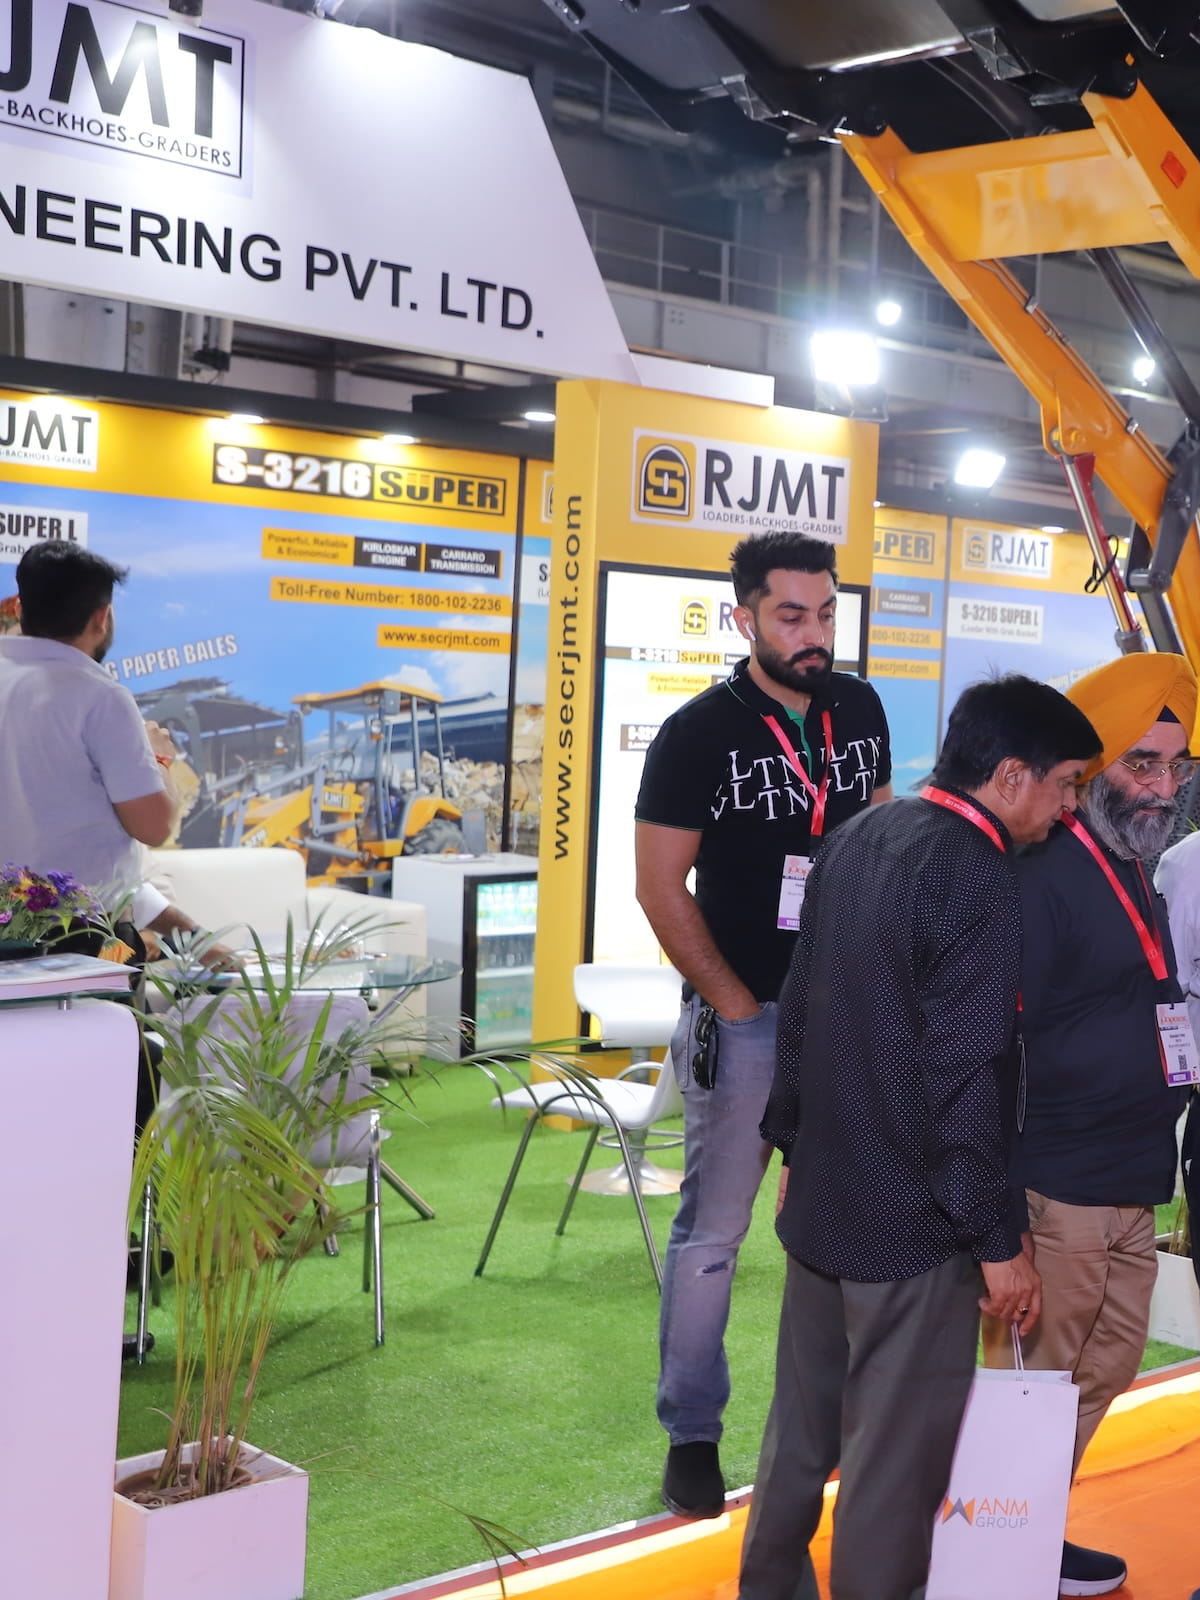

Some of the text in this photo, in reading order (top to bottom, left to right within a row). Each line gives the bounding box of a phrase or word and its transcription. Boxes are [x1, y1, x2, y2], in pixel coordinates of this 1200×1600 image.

[305, 245, 418, 311] PVT.
[440, 271, 545, 338] LTD.
[216, 446, 372, 499] S-3216
[703, 448, 845, 521] RJMT
[362, 541, 416, 556] KIRLOSKAR
[441, 549, 486, 563] CARRARO
[991, 533, 1049, 568] RJMT
[371, 553, 407, 567] ENGINE
[430, 558, 496, 575] TRANSMISSION
[278, 581, 502, 612] Toll-Free Number: 1800-102-2236
[1000, 608, 1032, 625] SUPER
[383, 630, 501, 649] www.secrjmt.com
[122, 647, 181, 679] PAPER
[183, 633, 238, 665] BALES
[554, 495, 582, 861] www.secrjmt.com
[976, 1496, 1030, 1517] ANM
[975, 1515, 1030, 1529] GROUP
